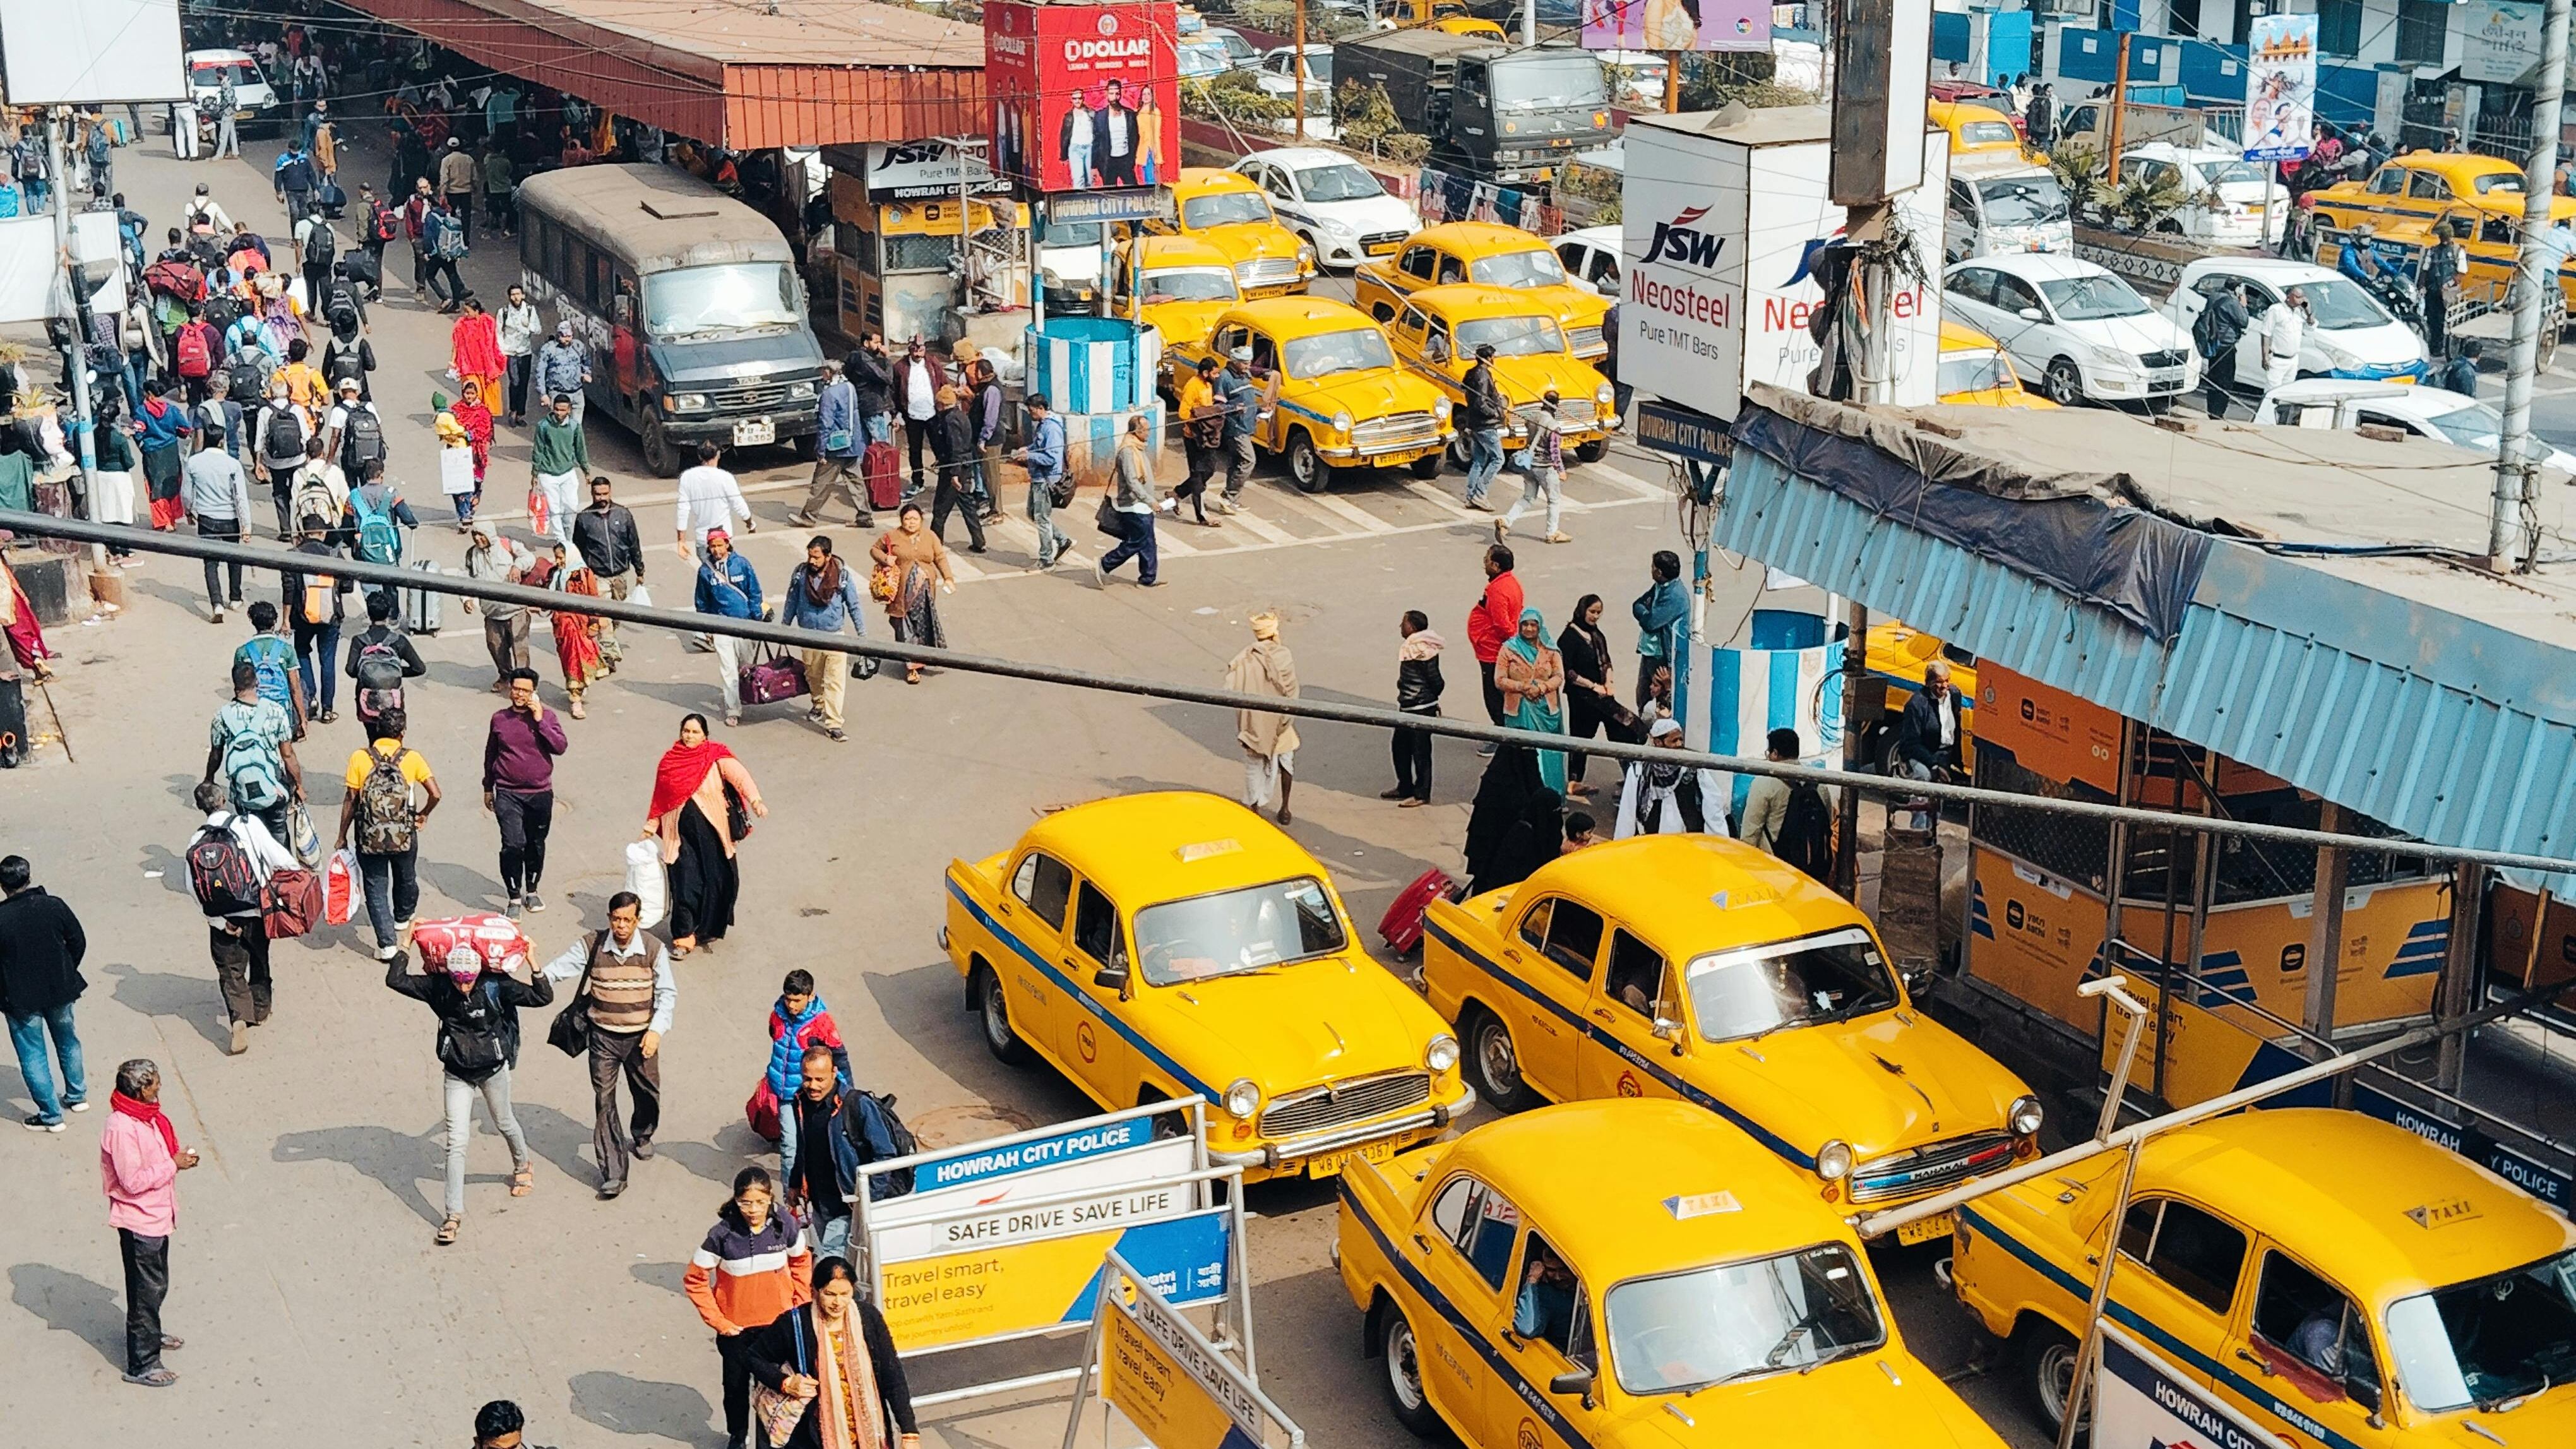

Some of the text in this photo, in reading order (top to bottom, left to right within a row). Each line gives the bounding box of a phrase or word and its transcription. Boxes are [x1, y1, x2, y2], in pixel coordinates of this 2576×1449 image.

[1082, 39, 1151, 58] DOLLAR
[873, 144, 945, 172] JSW
[894, 186, 945, 198] HOWRAH
[1100, 197, 1124, 214] CITY
[1638, 222, 1726, 269] JSW
[1631, 268, 1729, 329] Neosteel
[1640, 320, 1719, 361] Pure TMT Bars
[1779, 347, 1820, 364] Pure
[1639, 413, 1676, 443] HOWRAH
[1678, 422, 1698, 450] CITY
[2395, 1111, 2460, 1153] HOWRAH
[937, 1127, 1131, 1183] HOWRAH CITY POLICE
[2502, 1159, 2558, 1199] POLICE
[948, 1193, 1169, 1242] SAFE DRIVE SAVE LIFE
[1685, 1195, 1729, 1211] TAXI
[2431, 1201, 2471, 1221] TAXI
[883, 1259, 1005, 1289] Travel smart,
[883, 1283, 987, 1310] travel easy
[1116, 1316, 1143, 1354] Travel
[1143, 1301, 1169, 1340] SAFE
[1171, 1328, 1200, 1371] DRIVE
[1202, 1360, 1231, 1402] SAVE
[1232, 1388, 1255, 1425] LIFE
[1142, 1370, 1166, 1402] easy
[2155, 1380, 2223, 1440] HOWRAH
